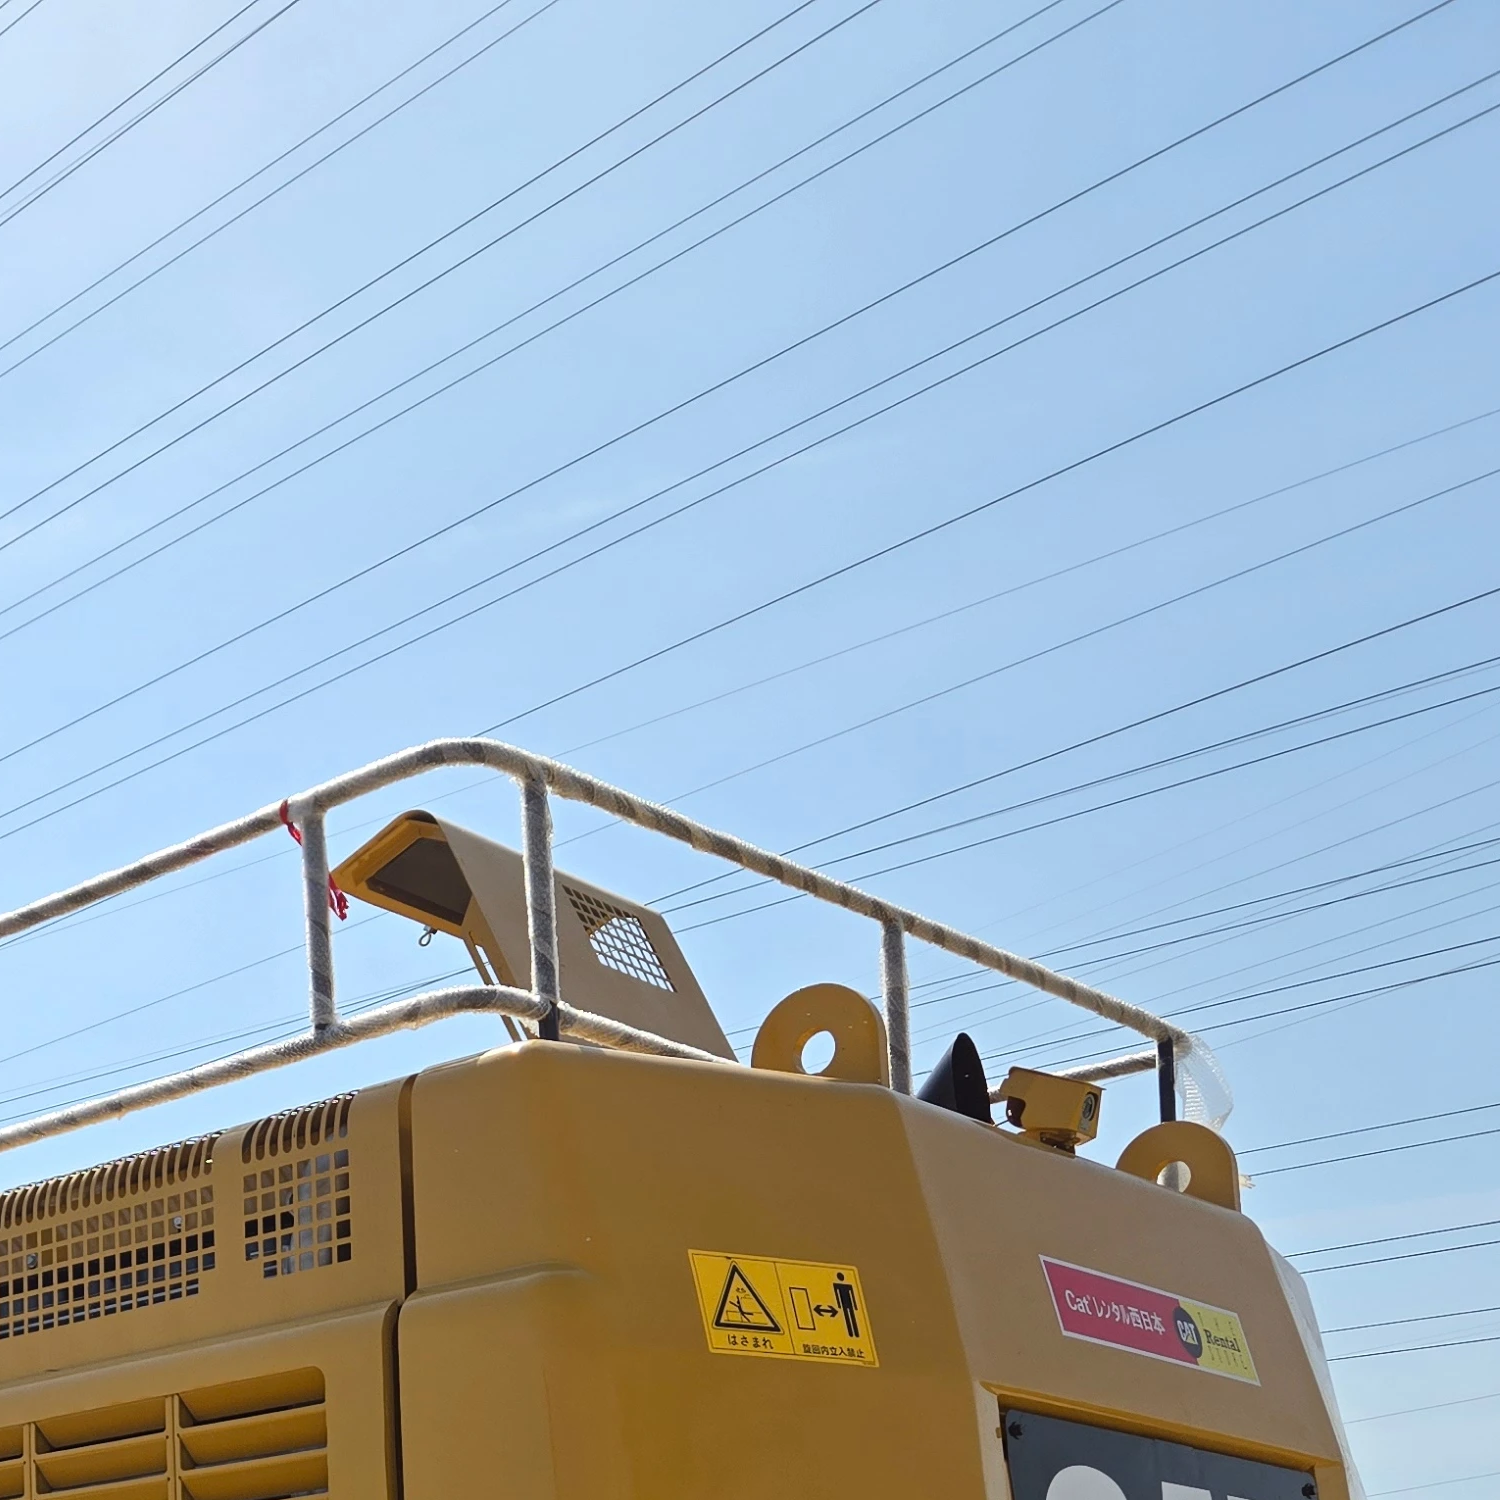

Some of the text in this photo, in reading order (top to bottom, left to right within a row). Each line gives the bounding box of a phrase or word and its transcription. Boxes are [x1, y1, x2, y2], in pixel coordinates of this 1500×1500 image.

[1094, 1297, 1166, 1335] レンタル西日本
[727, 1333, 774, 1350] はさまれ
[1177, 1320, 1199, 1346] CAT
[1203, 1328, 1241, 1353] Rental
